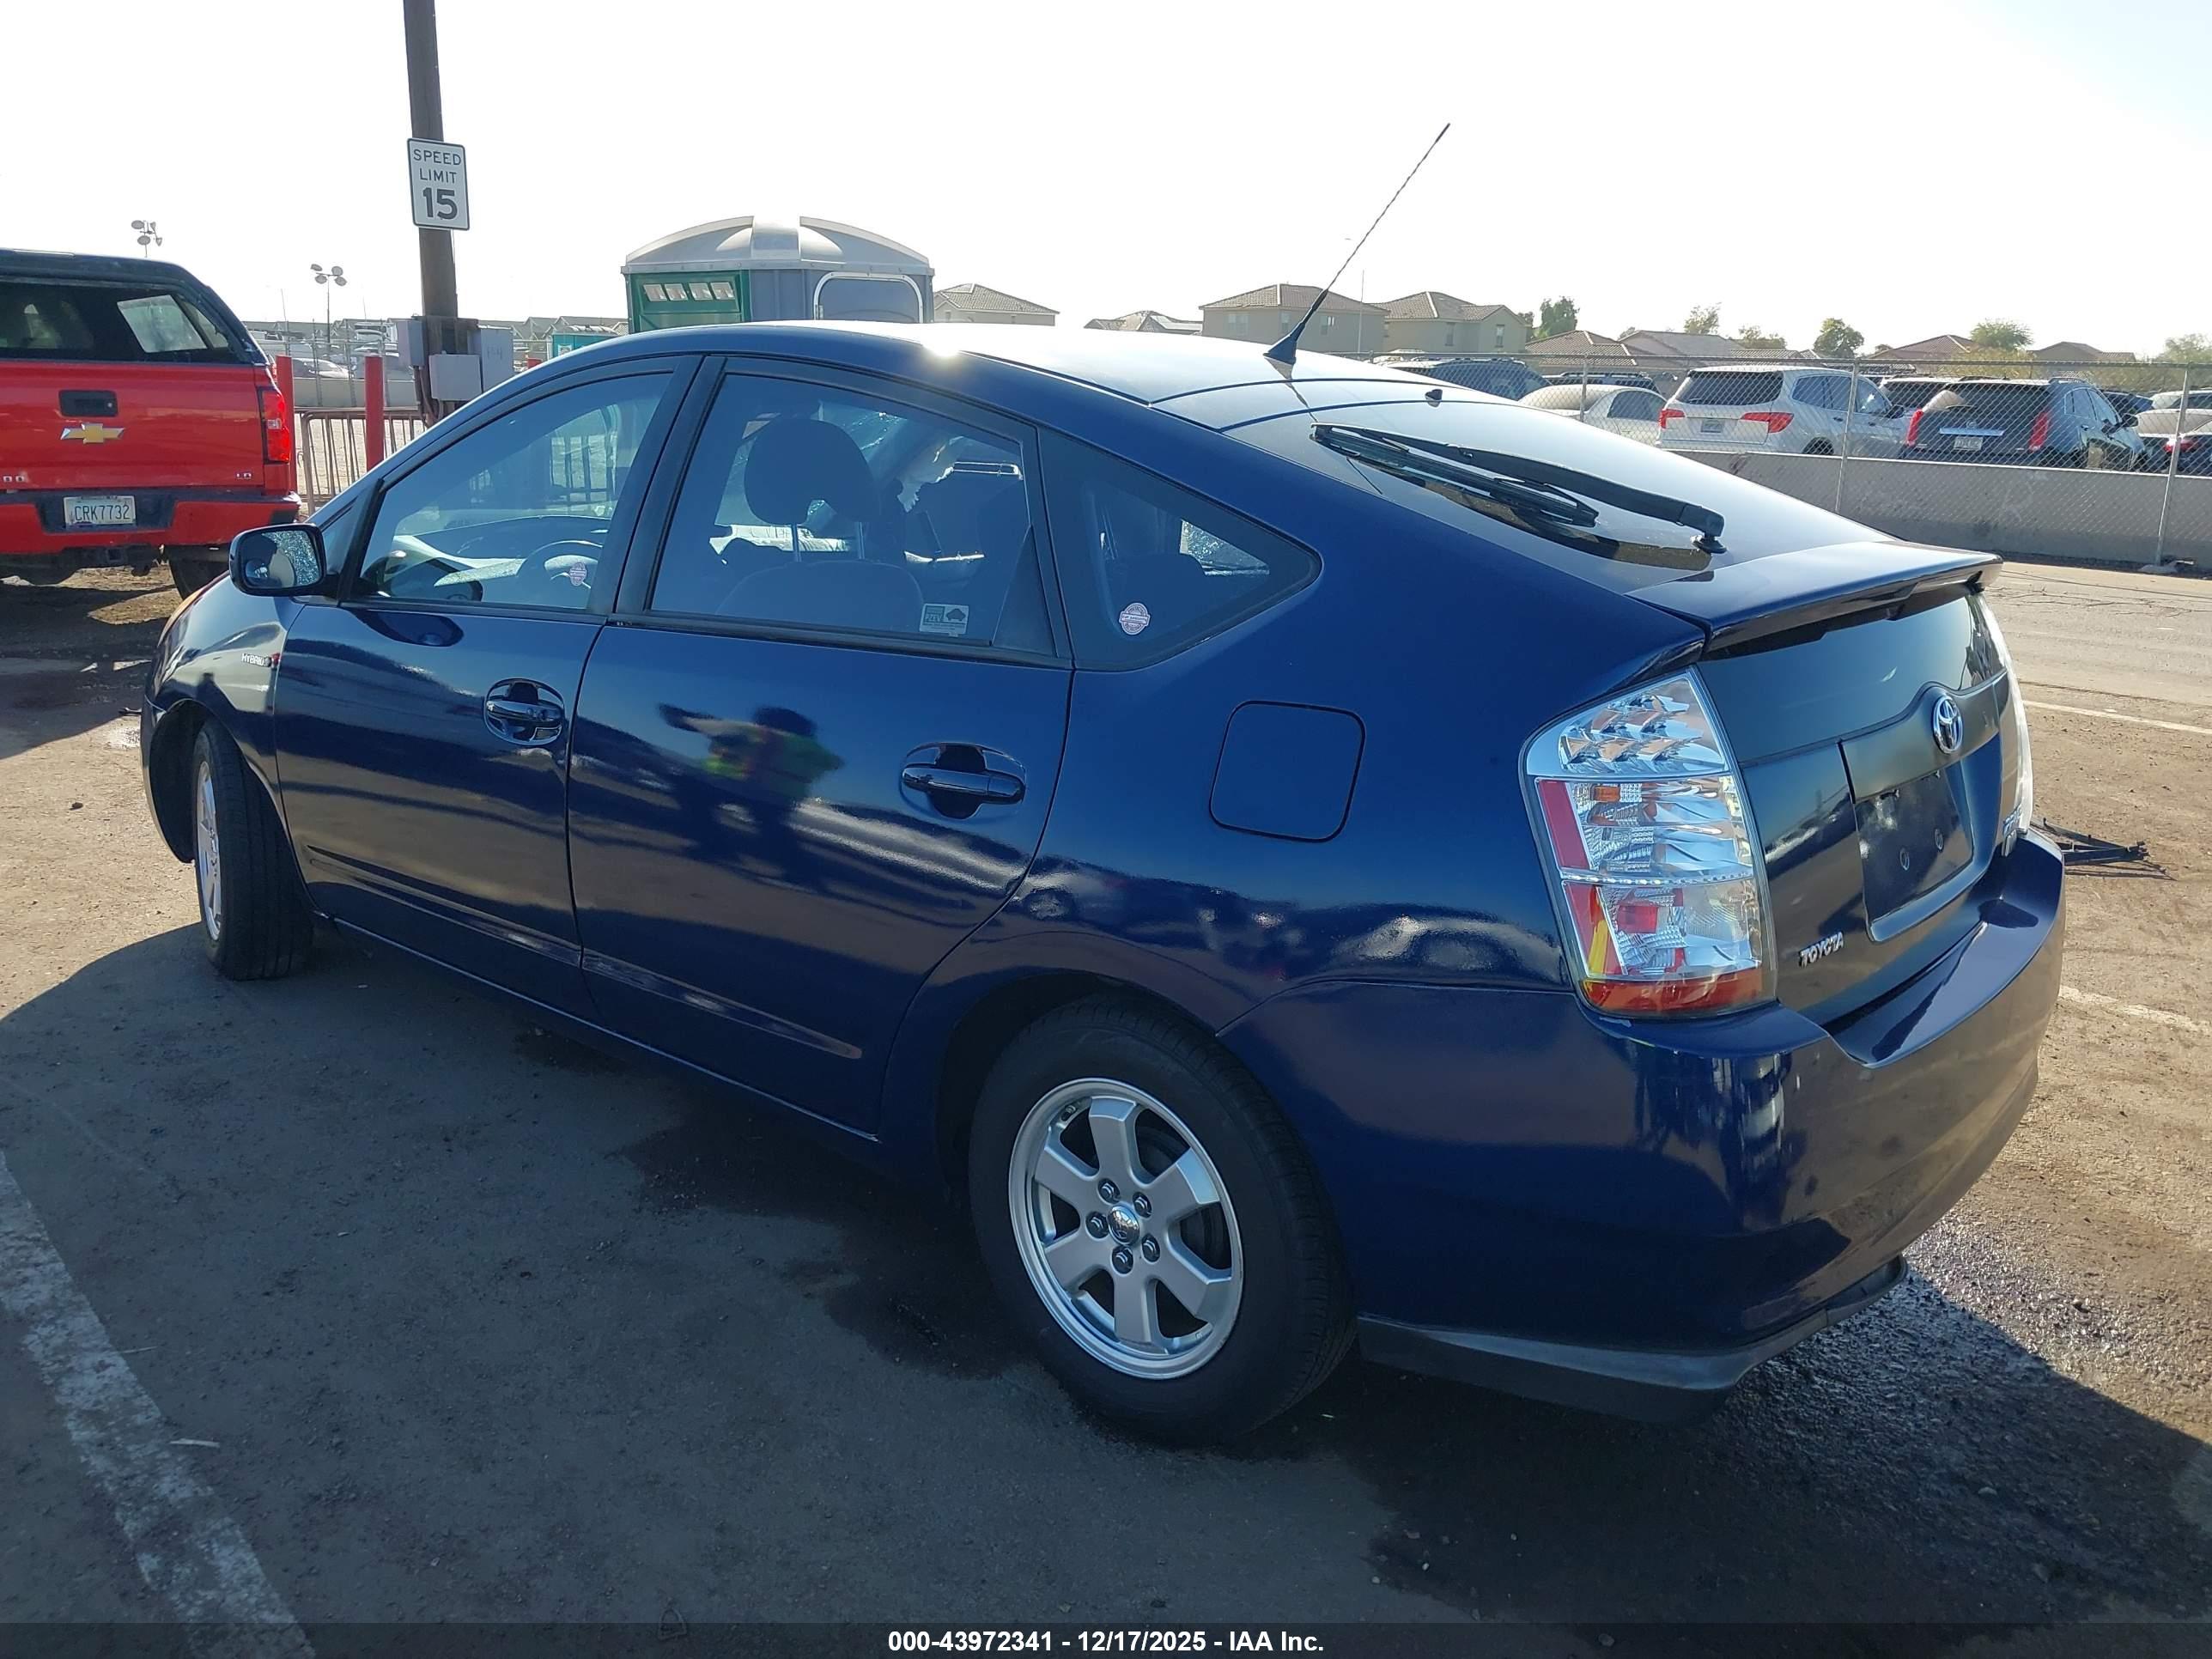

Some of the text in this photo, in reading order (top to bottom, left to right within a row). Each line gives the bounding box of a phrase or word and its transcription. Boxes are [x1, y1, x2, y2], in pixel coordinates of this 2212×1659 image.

[413, 149, 462, 166] SPEED
[419, 167, 457, 184] LIMIT
[422, 187, 458, 220] 15
[74, 504, 131, 521] CRK7732
[1799, 931, 1844, 969] TOYOTA
